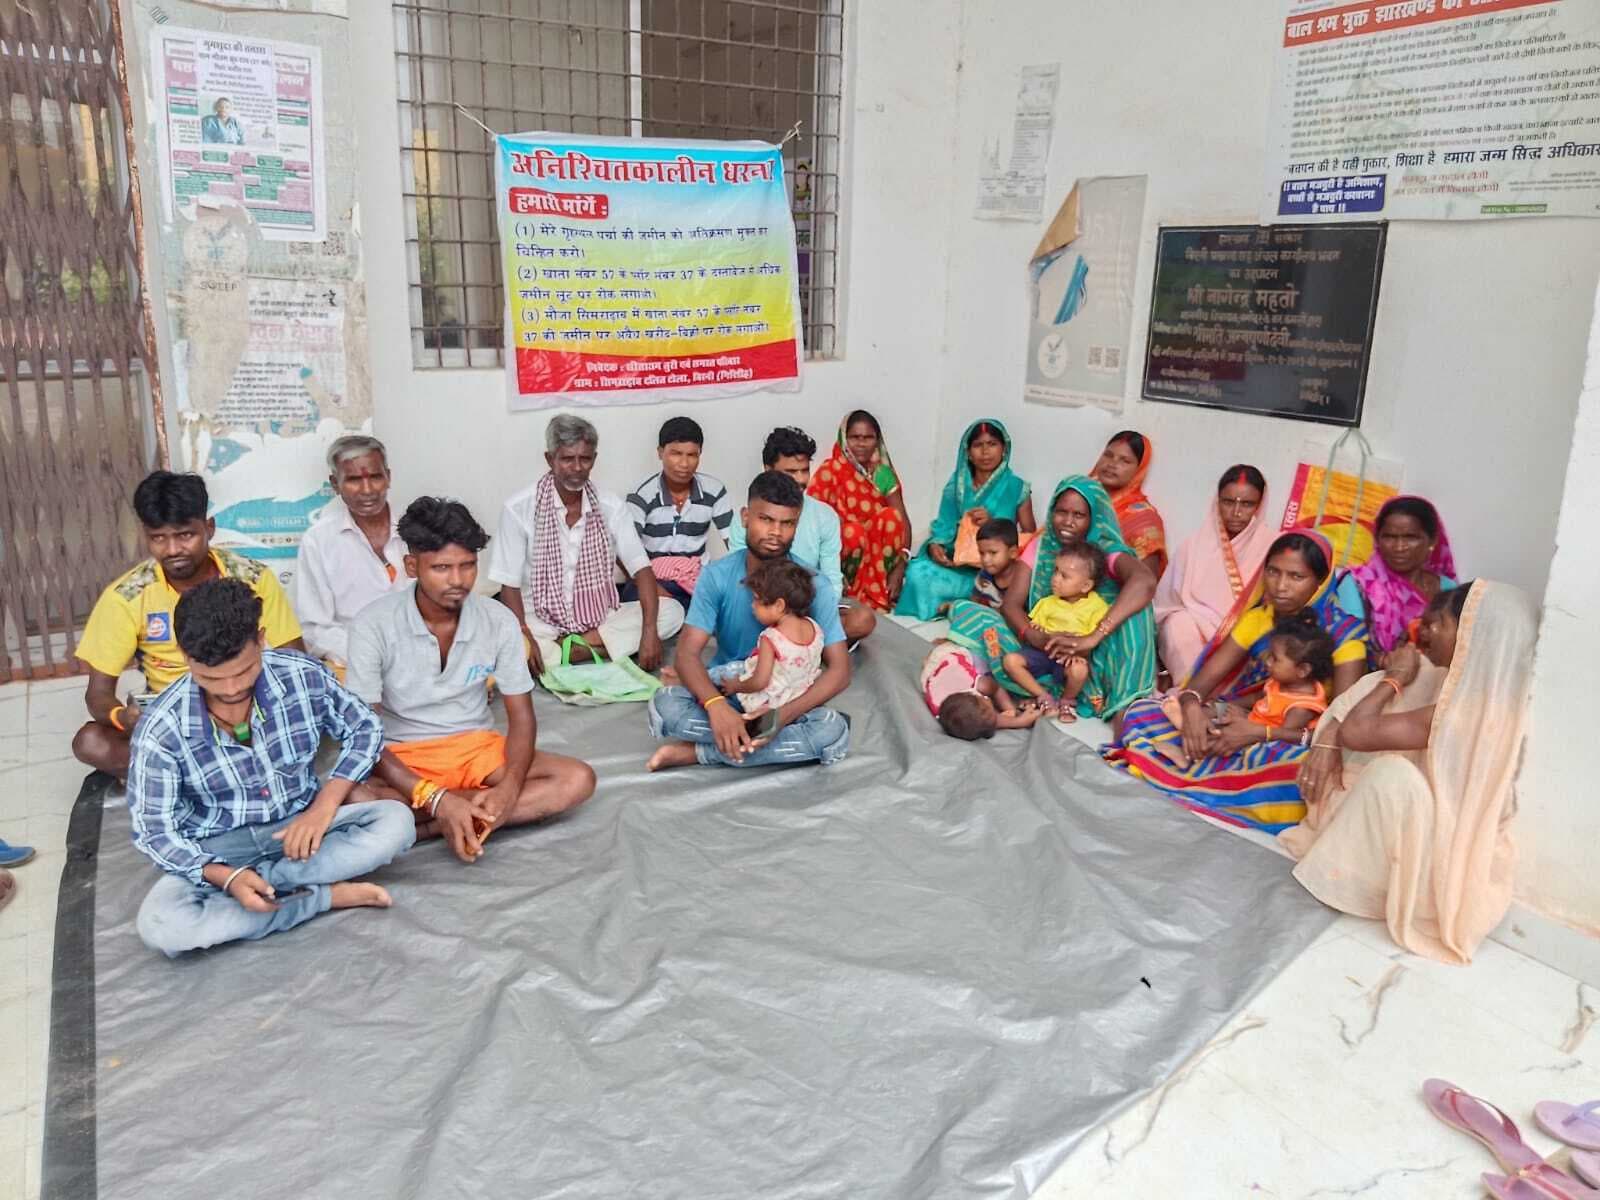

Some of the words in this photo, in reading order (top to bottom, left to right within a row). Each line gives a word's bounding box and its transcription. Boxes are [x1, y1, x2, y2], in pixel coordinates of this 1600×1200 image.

[1287, 20, 1314, 38] बाल
[1317, 14, 1340, 33] श्रम
[1343, 9, 1370, 33] मुक्त
[1443, 151, 1475, 163] हमारा
[1480, 149, 1508, 162] जन्म
[511, 150, 715, 183] अनिश्चितकालीन
[723, 160, 775, 183] धरना
[515, 193, 560, 213] हमारी
[515, 223, 535, 239] (1)
[540, 223, 556, 235] मेरे
[638, 228, 666, 240] जमीन
[518, 265, 537, 280] (2)
[542, 269, 570, 279] खाता
[680, 270, 693, 281] 37
[519, 287, 551, 299] जमीन
[576, 290, 592, 300] पर
[1256, 283, 1299, 312] महतो
[521, 308, 540, 324] (3)
[524, 331, 538, 343] 37
[596, 330, 611, 340] पर
